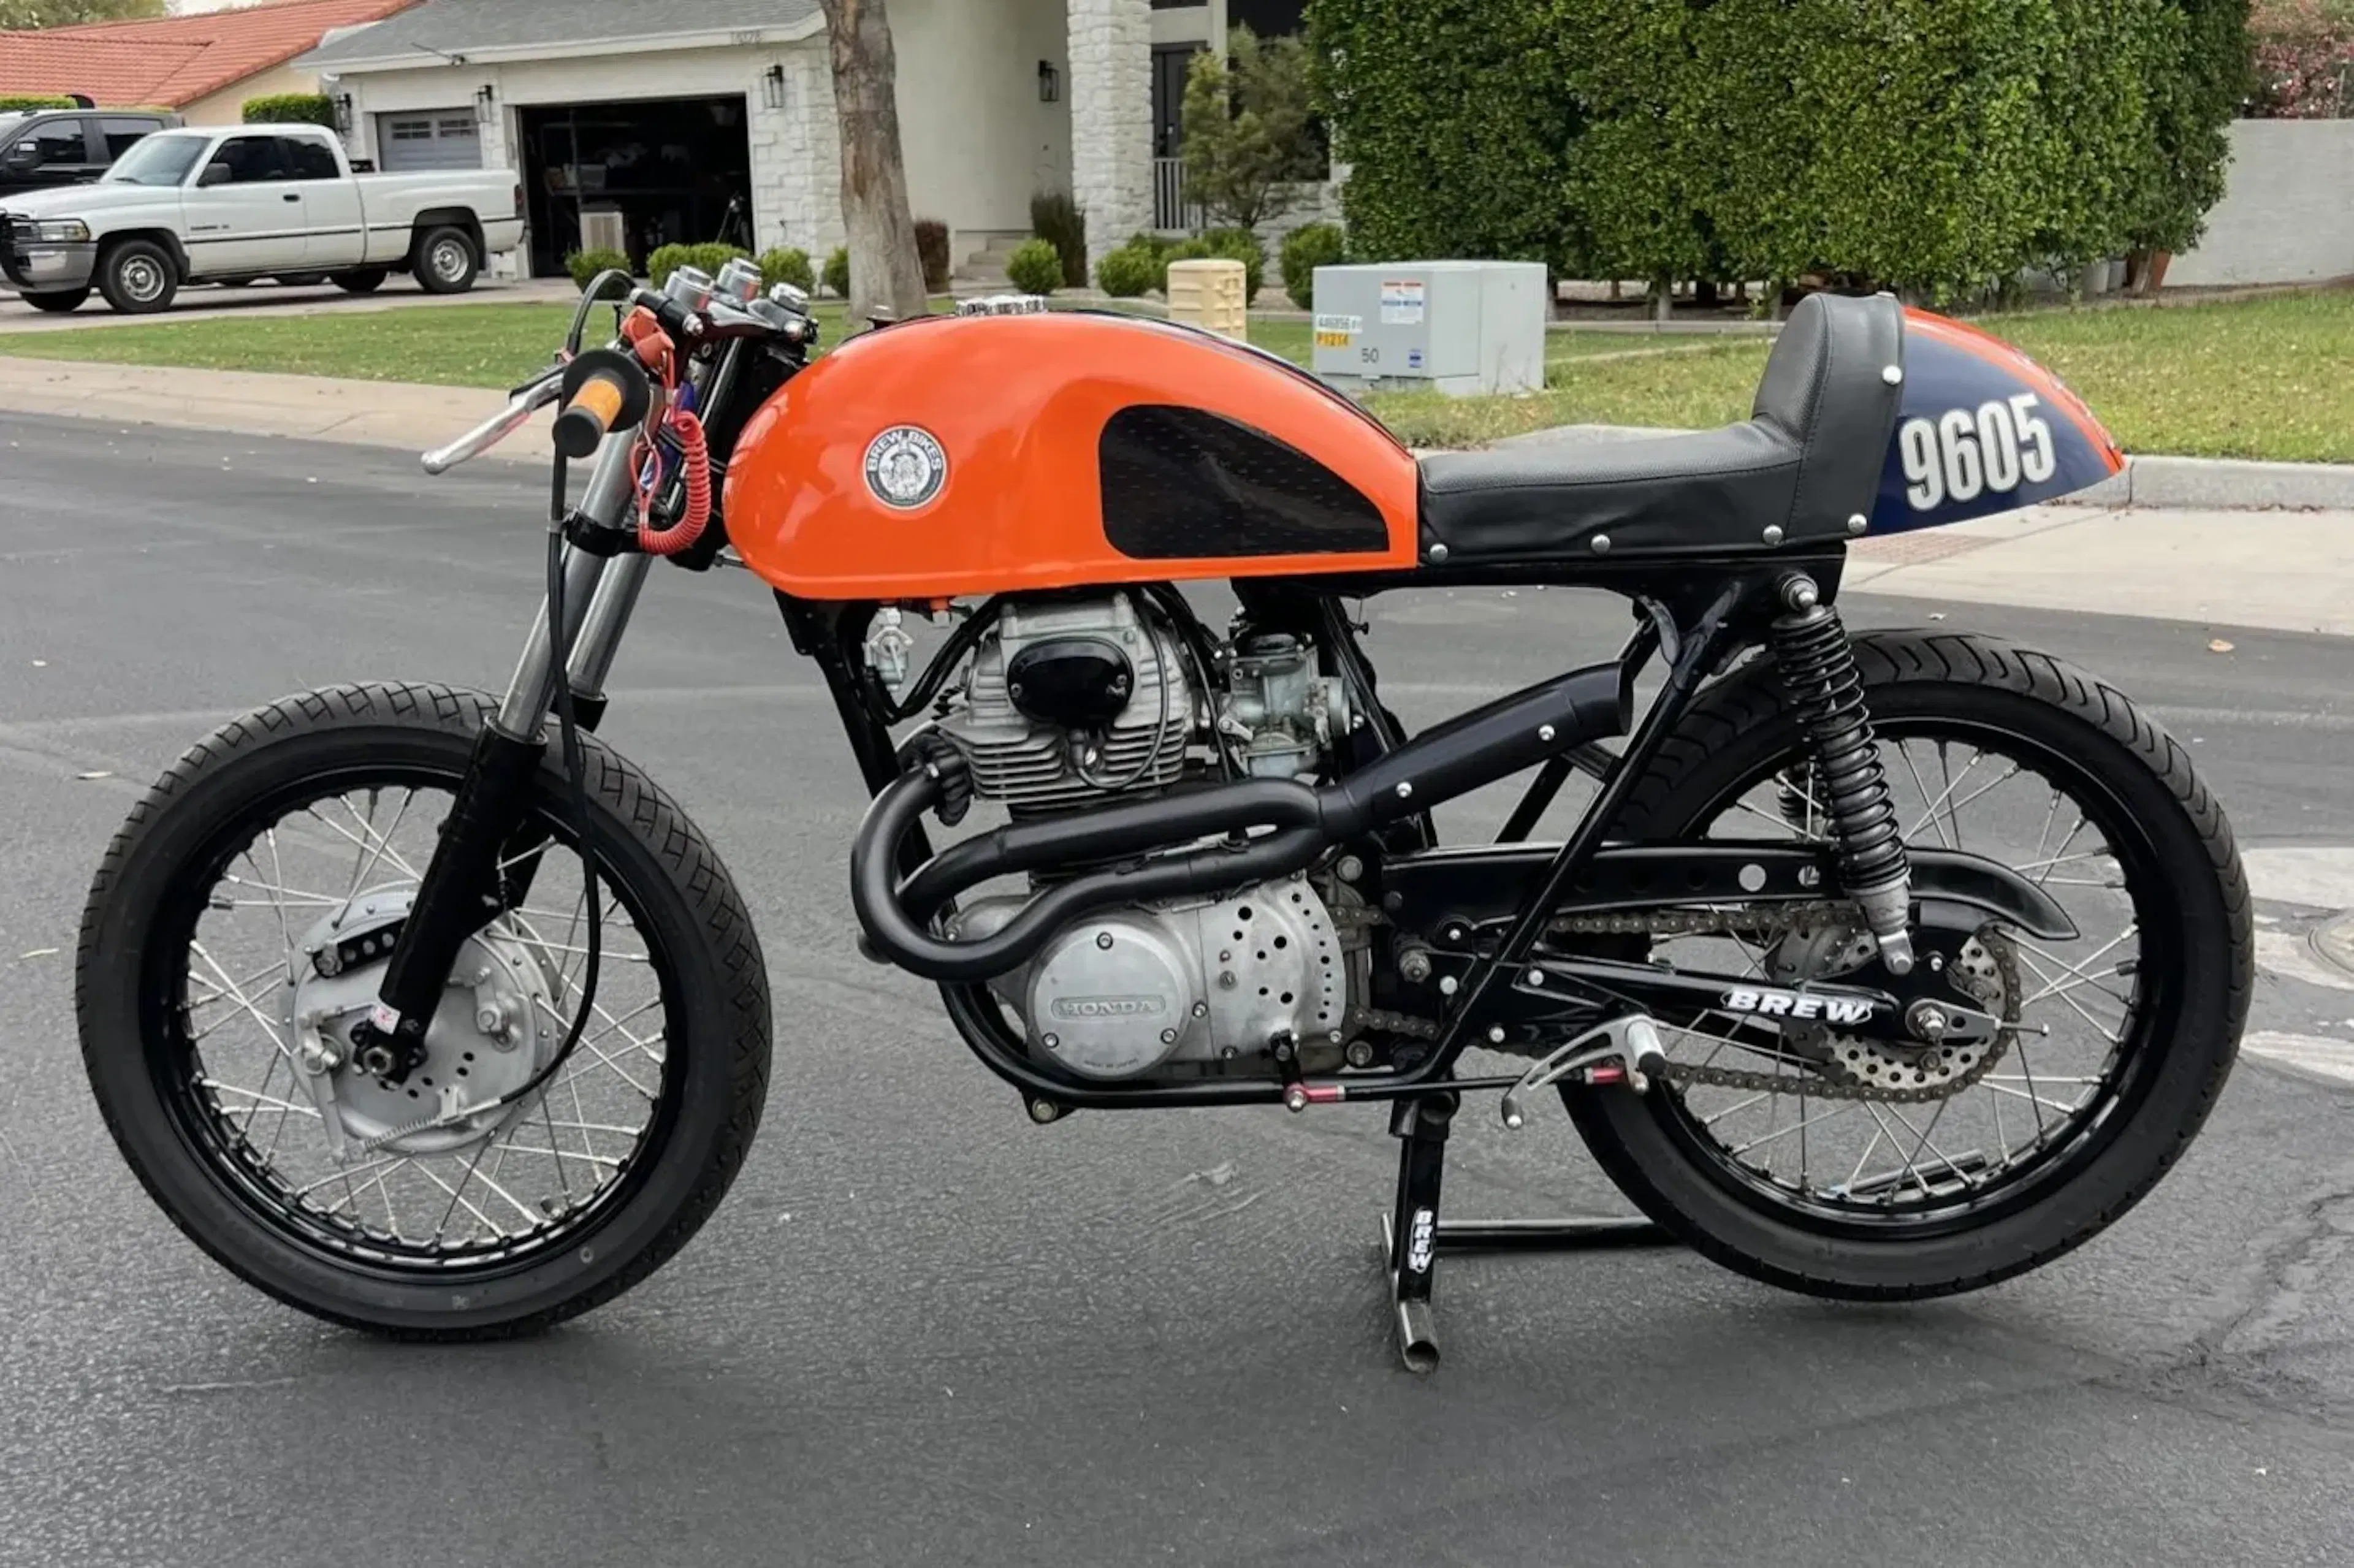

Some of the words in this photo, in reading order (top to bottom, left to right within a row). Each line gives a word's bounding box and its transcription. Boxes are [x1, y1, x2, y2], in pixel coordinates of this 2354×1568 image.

[1362, 348, 1379, 363] 50
[866, 430, 903, 472] BREW
[908, 430, 942, 471] BIKES
[1900, 392, 2055, 511] 9605
[1060, 1000, 1156, 1016] HONDA
[1727, 988, 1873, 1023] BREW
[1409, 1210, 1433, 1271] BREW
